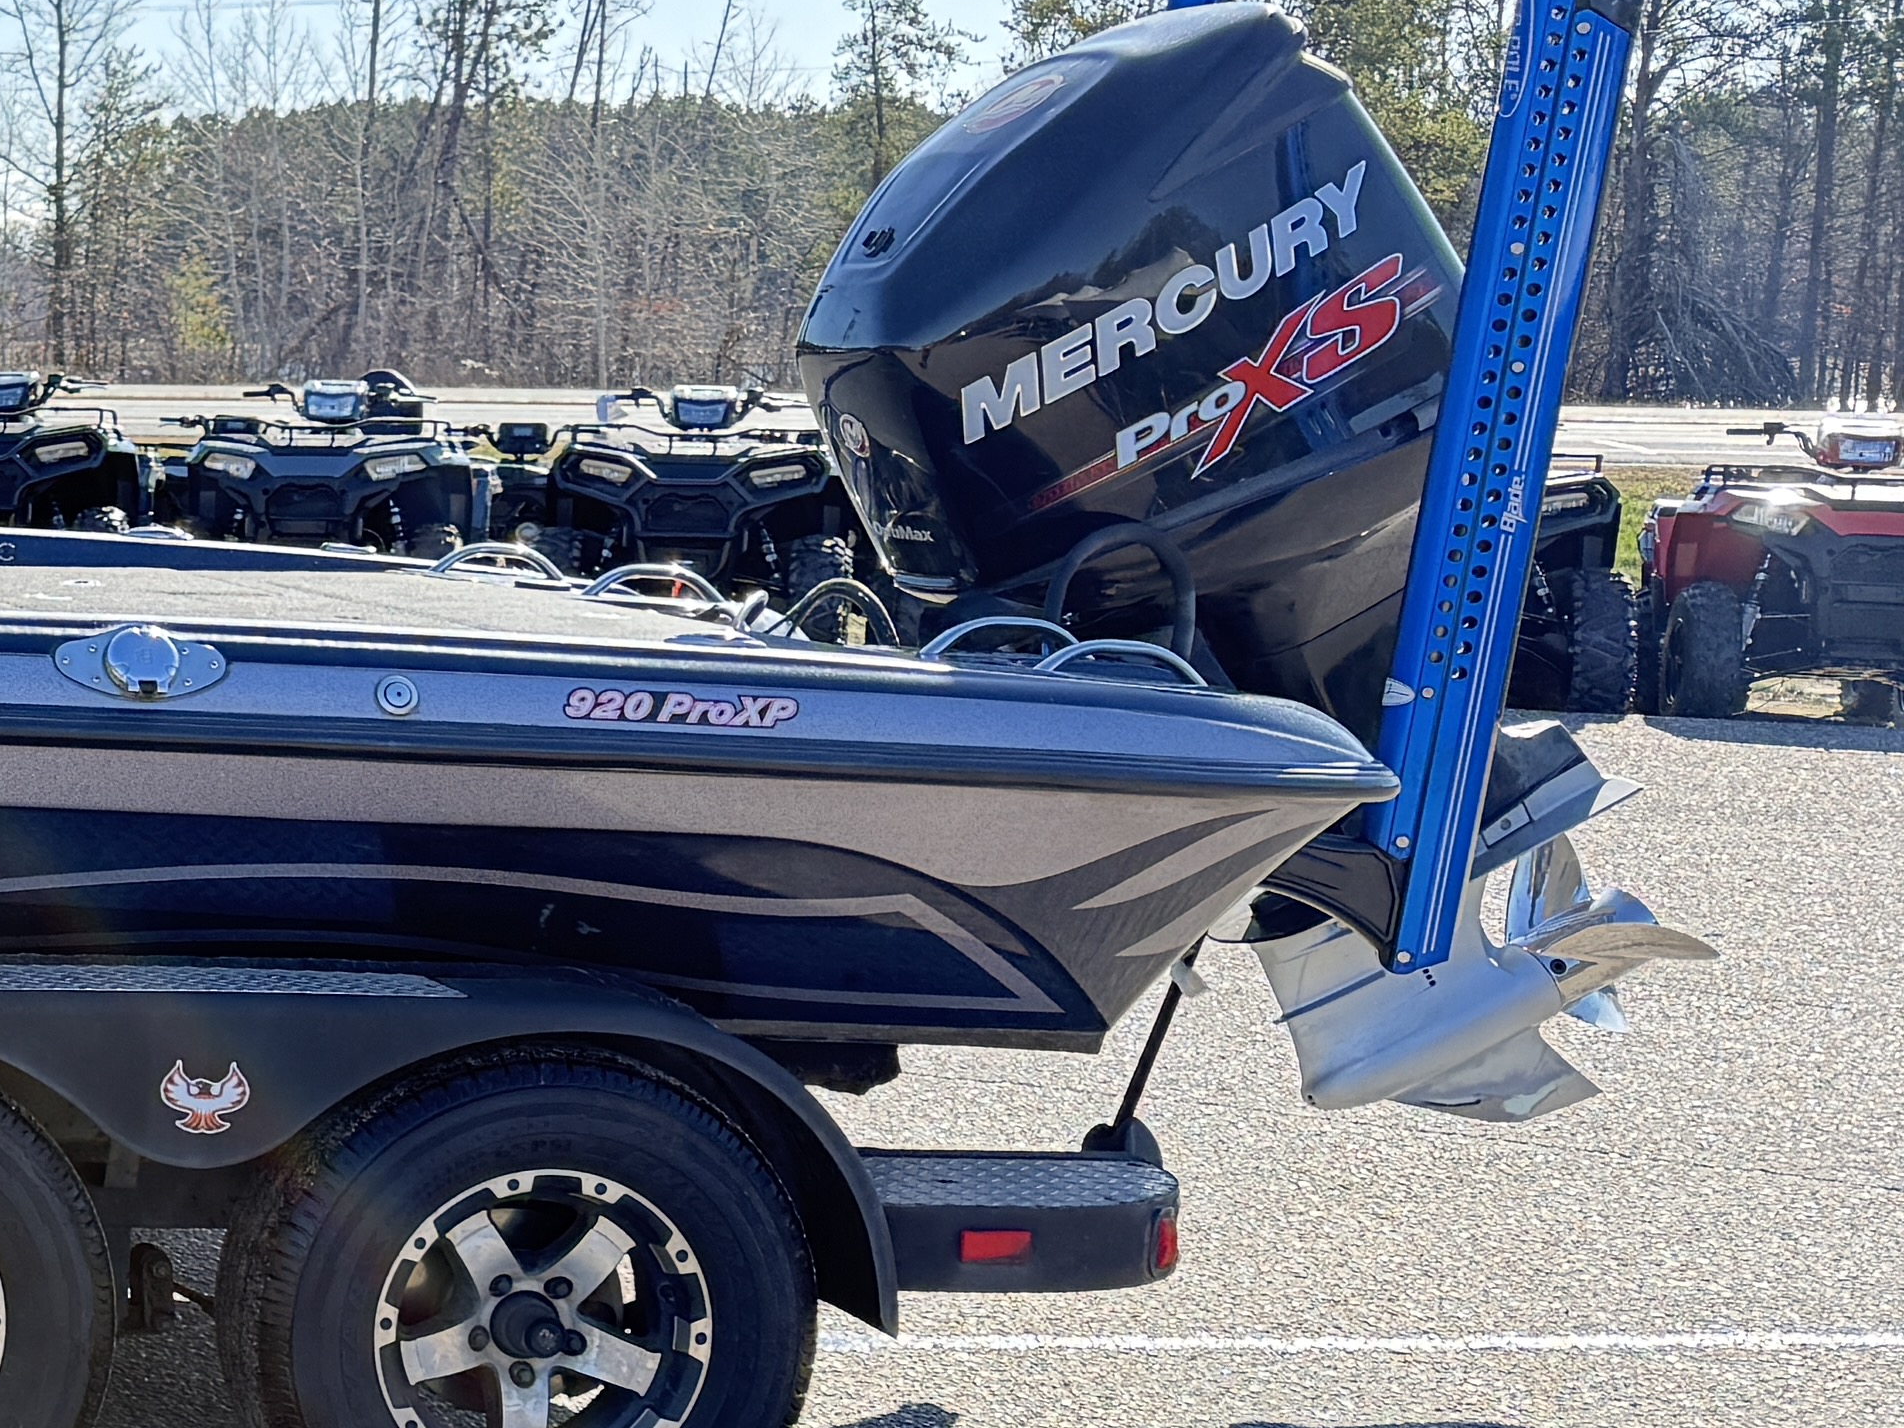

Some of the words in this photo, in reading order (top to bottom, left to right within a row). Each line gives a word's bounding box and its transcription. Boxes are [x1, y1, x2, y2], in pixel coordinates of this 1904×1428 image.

[960, 159, 1367, 445] MERCURY
[563, 686, 655, 721] 920
[656, 691, 799, 728] ProXP
